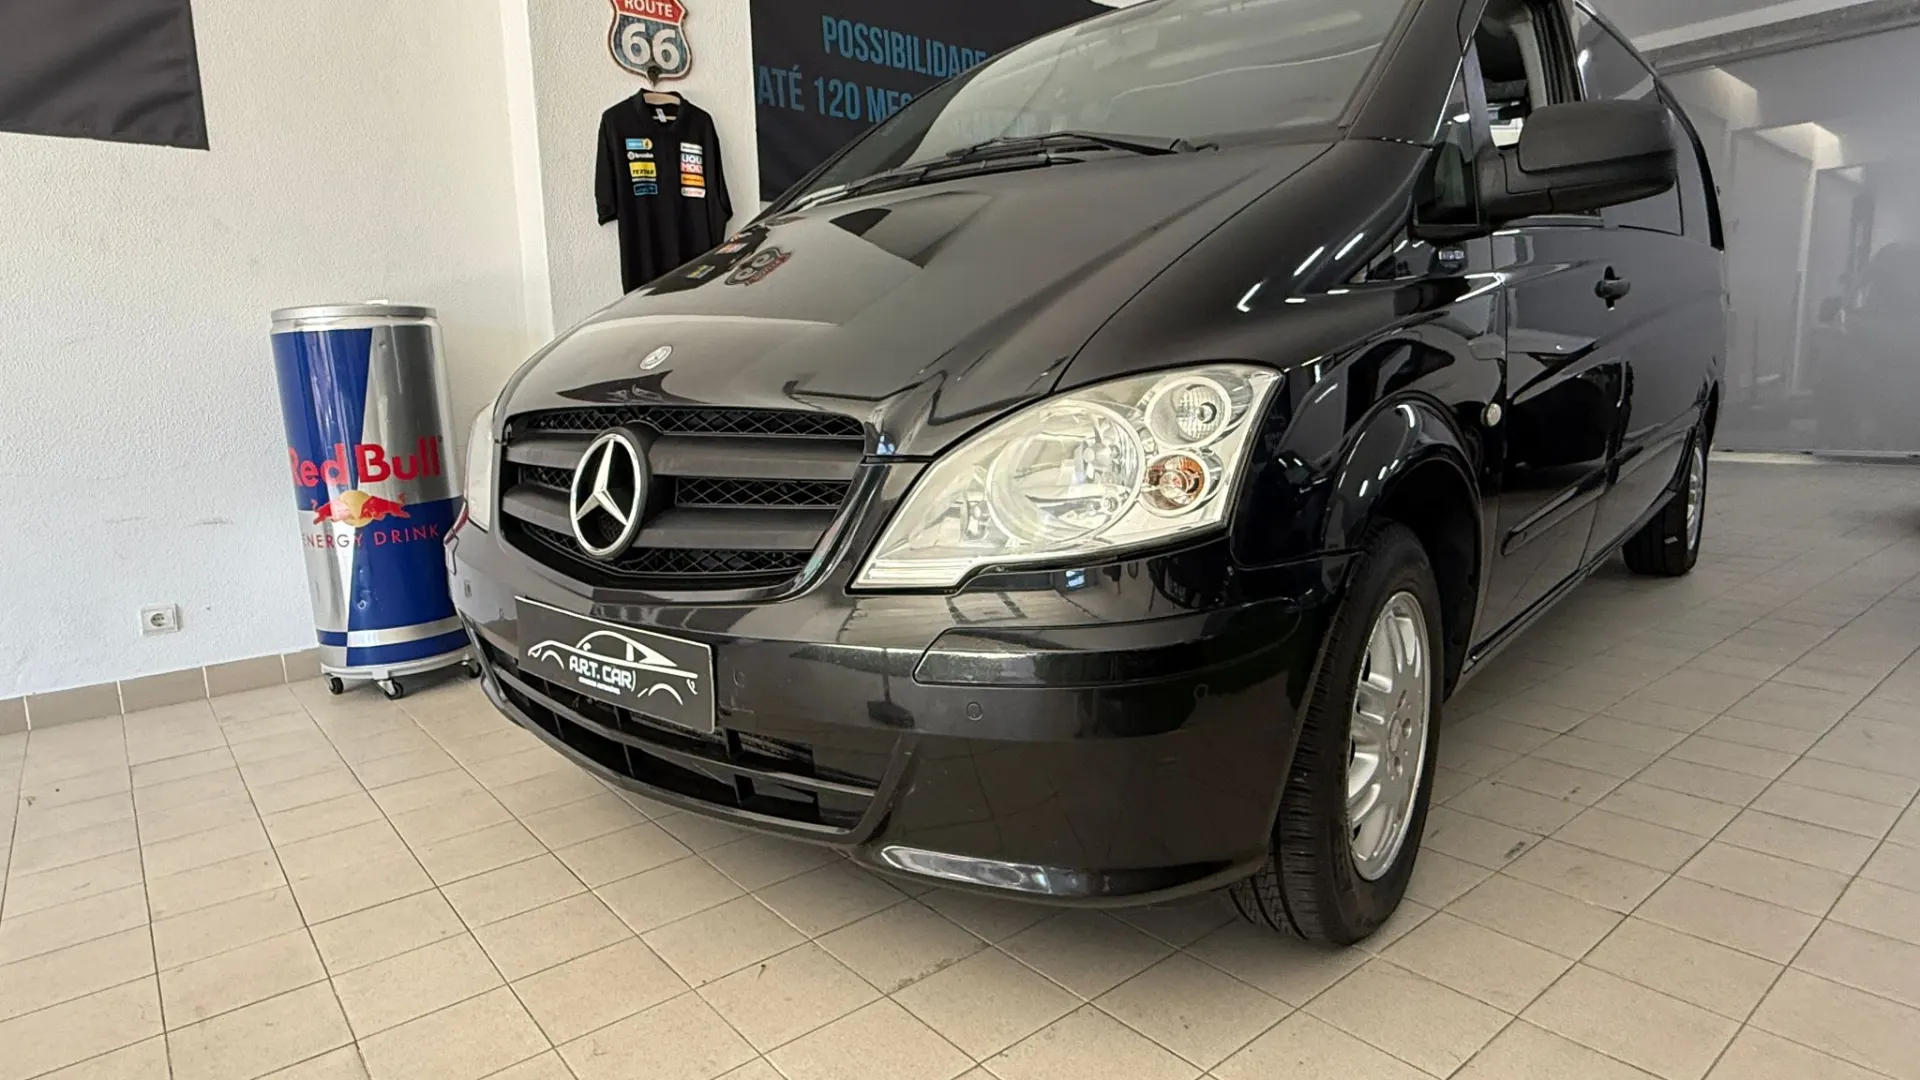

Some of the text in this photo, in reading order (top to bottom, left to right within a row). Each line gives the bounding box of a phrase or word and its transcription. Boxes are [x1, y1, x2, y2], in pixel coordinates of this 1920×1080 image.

[624, 0, 674, 17] ROUTE
[621, 22, 680, 70] 66
[758, 64, 805, 112] ATÉ
[814, 75, 861, 121] 120
[288, 435, 441, 487] Red Bull
[373, 524, 440, 546] DRINK
[602, 664, 633, 690] CAR
